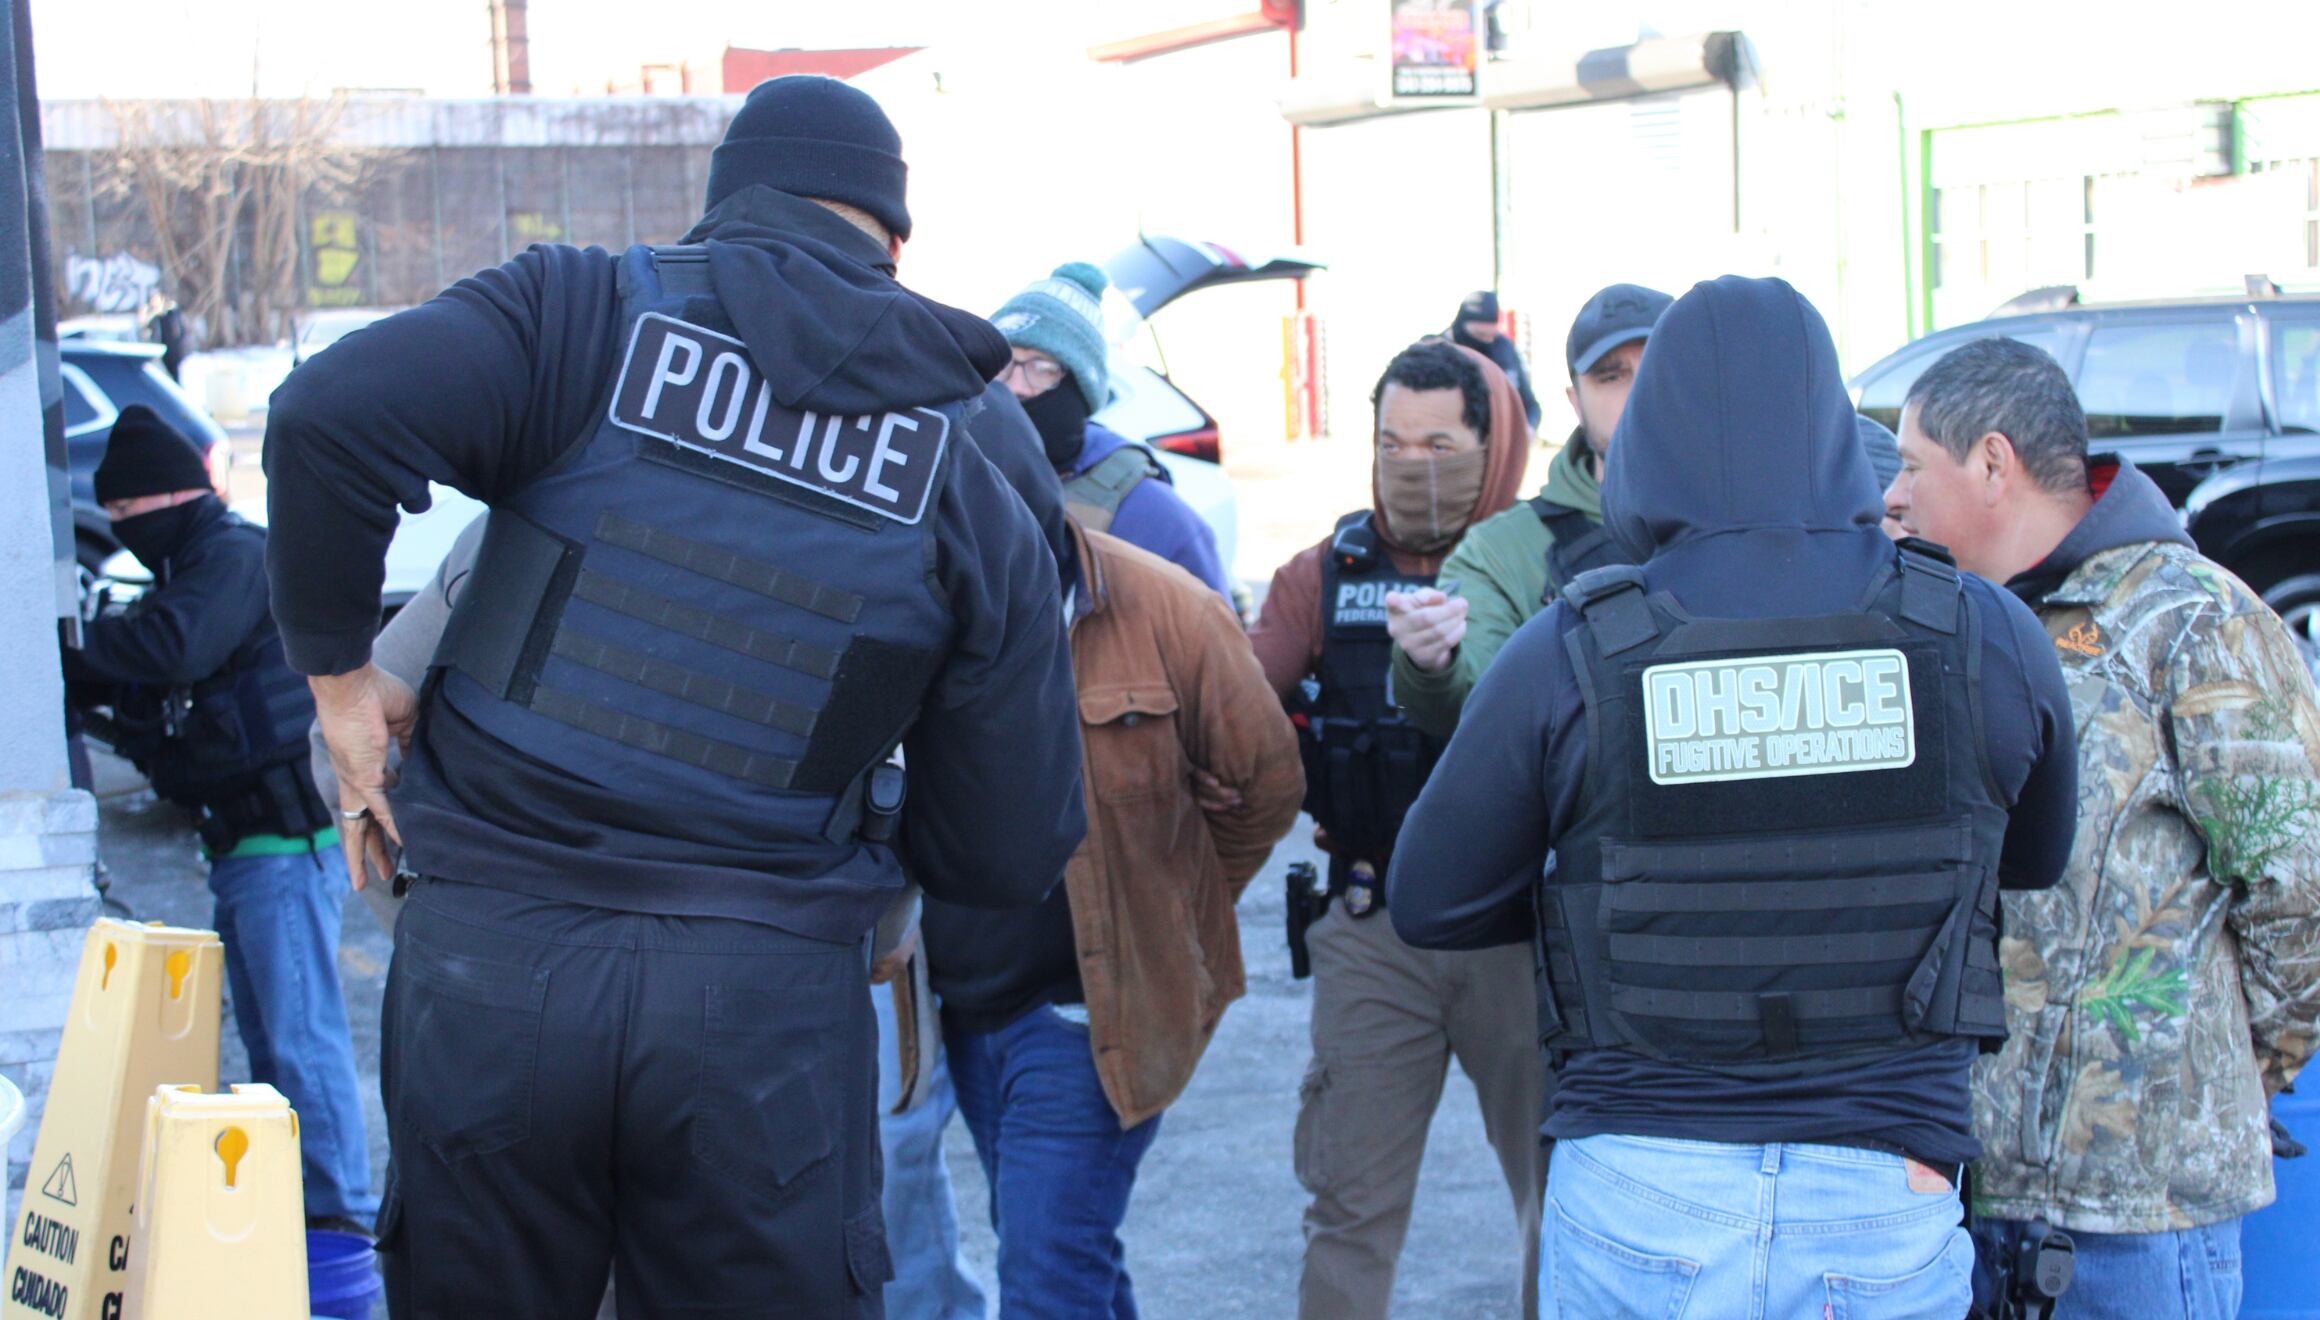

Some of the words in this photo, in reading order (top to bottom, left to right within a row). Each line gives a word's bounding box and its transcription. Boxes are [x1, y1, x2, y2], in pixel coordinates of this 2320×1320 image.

[641, 331, 919, 504] POLICE
[1335, 608, 1388, 622] FEDERA
[1337, 582, 1420, 608] POL
[1651, 657, 1905, 740] DHS/ICE
[1657, 736, 1761, 775] FUGITIVE
[1766, 726, 1905, 767] OPERATIONS
[23, 1210, 80, 1266] CAUTION
[11, 1265, 68, 1320] CUIDADO
